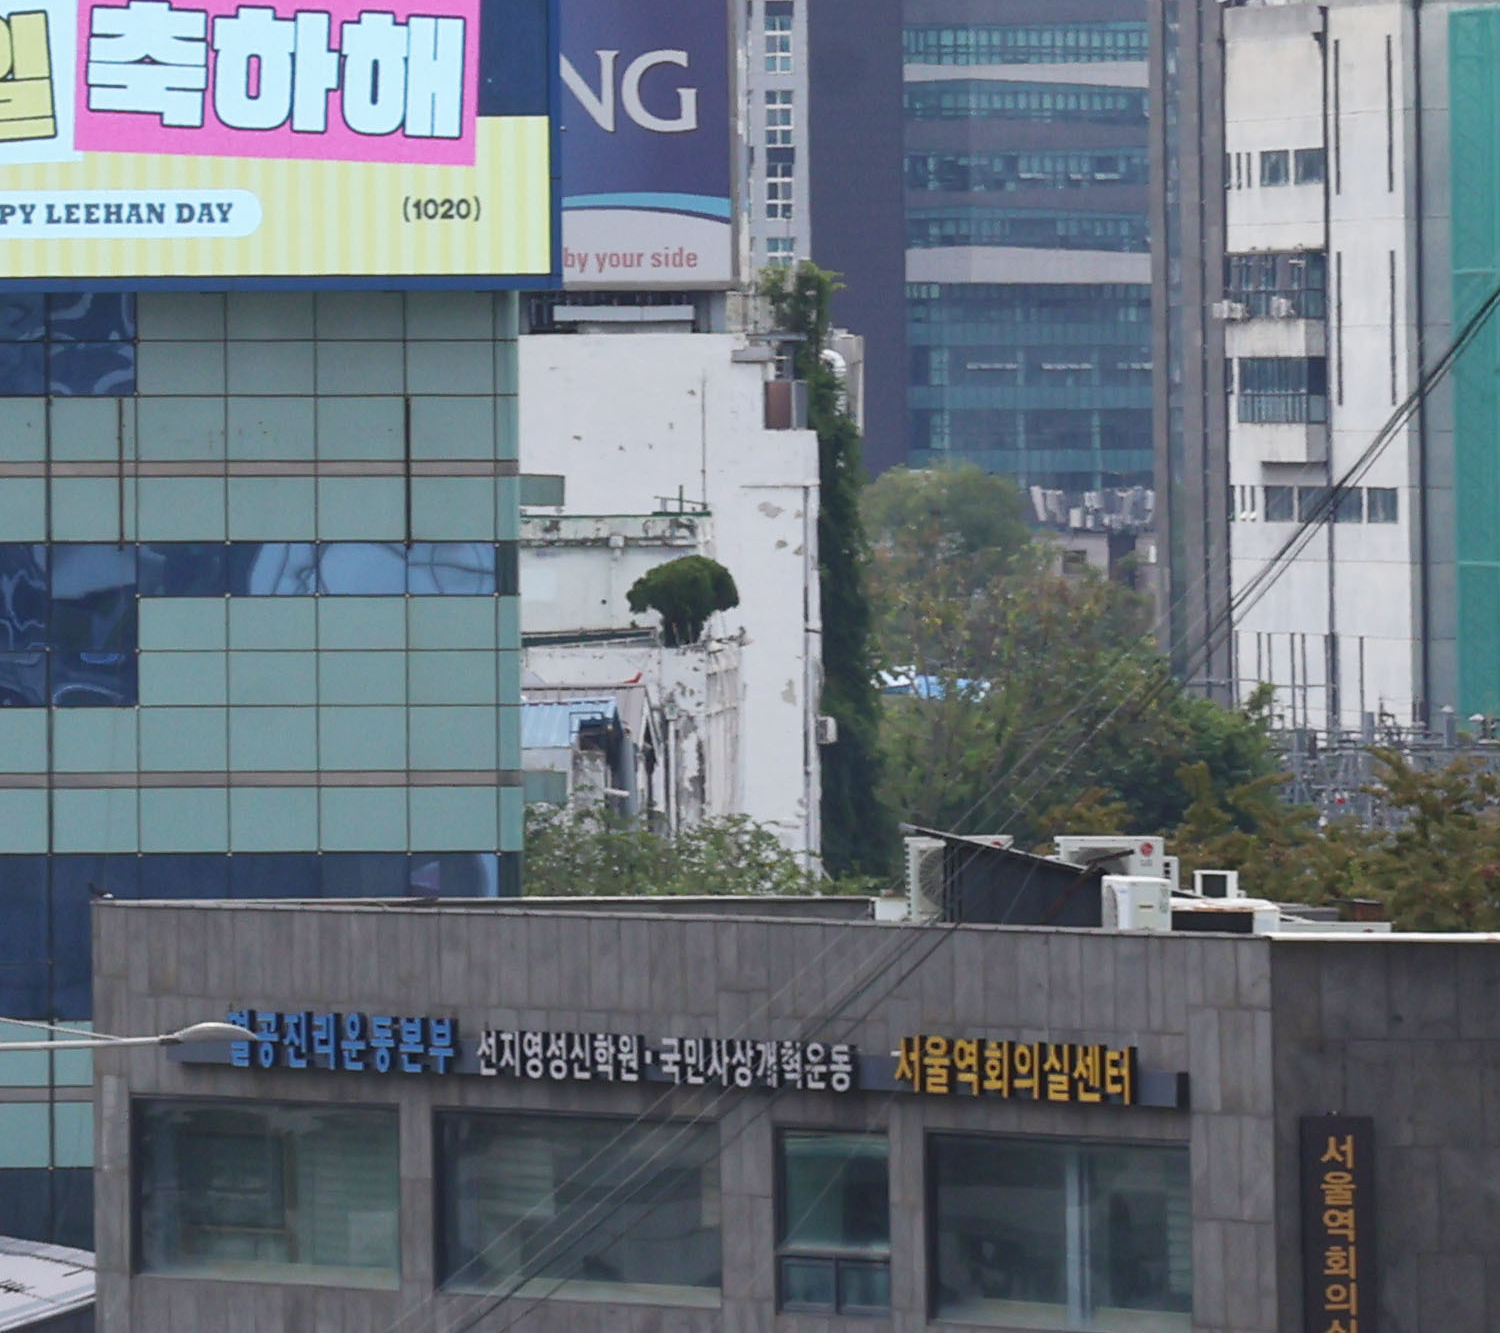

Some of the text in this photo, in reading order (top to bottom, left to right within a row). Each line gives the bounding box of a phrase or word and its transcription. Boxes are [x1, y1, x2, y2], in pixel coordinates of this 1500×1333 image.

[45, 202, 168, 226] LEEHAN
[176, 202, 234, 224] DAY
[402, 196, 482, 222] (1020)
[563, 247, 698, 273] by your side
[894, 1035, 1133, 1106] 서울역회의실센터
